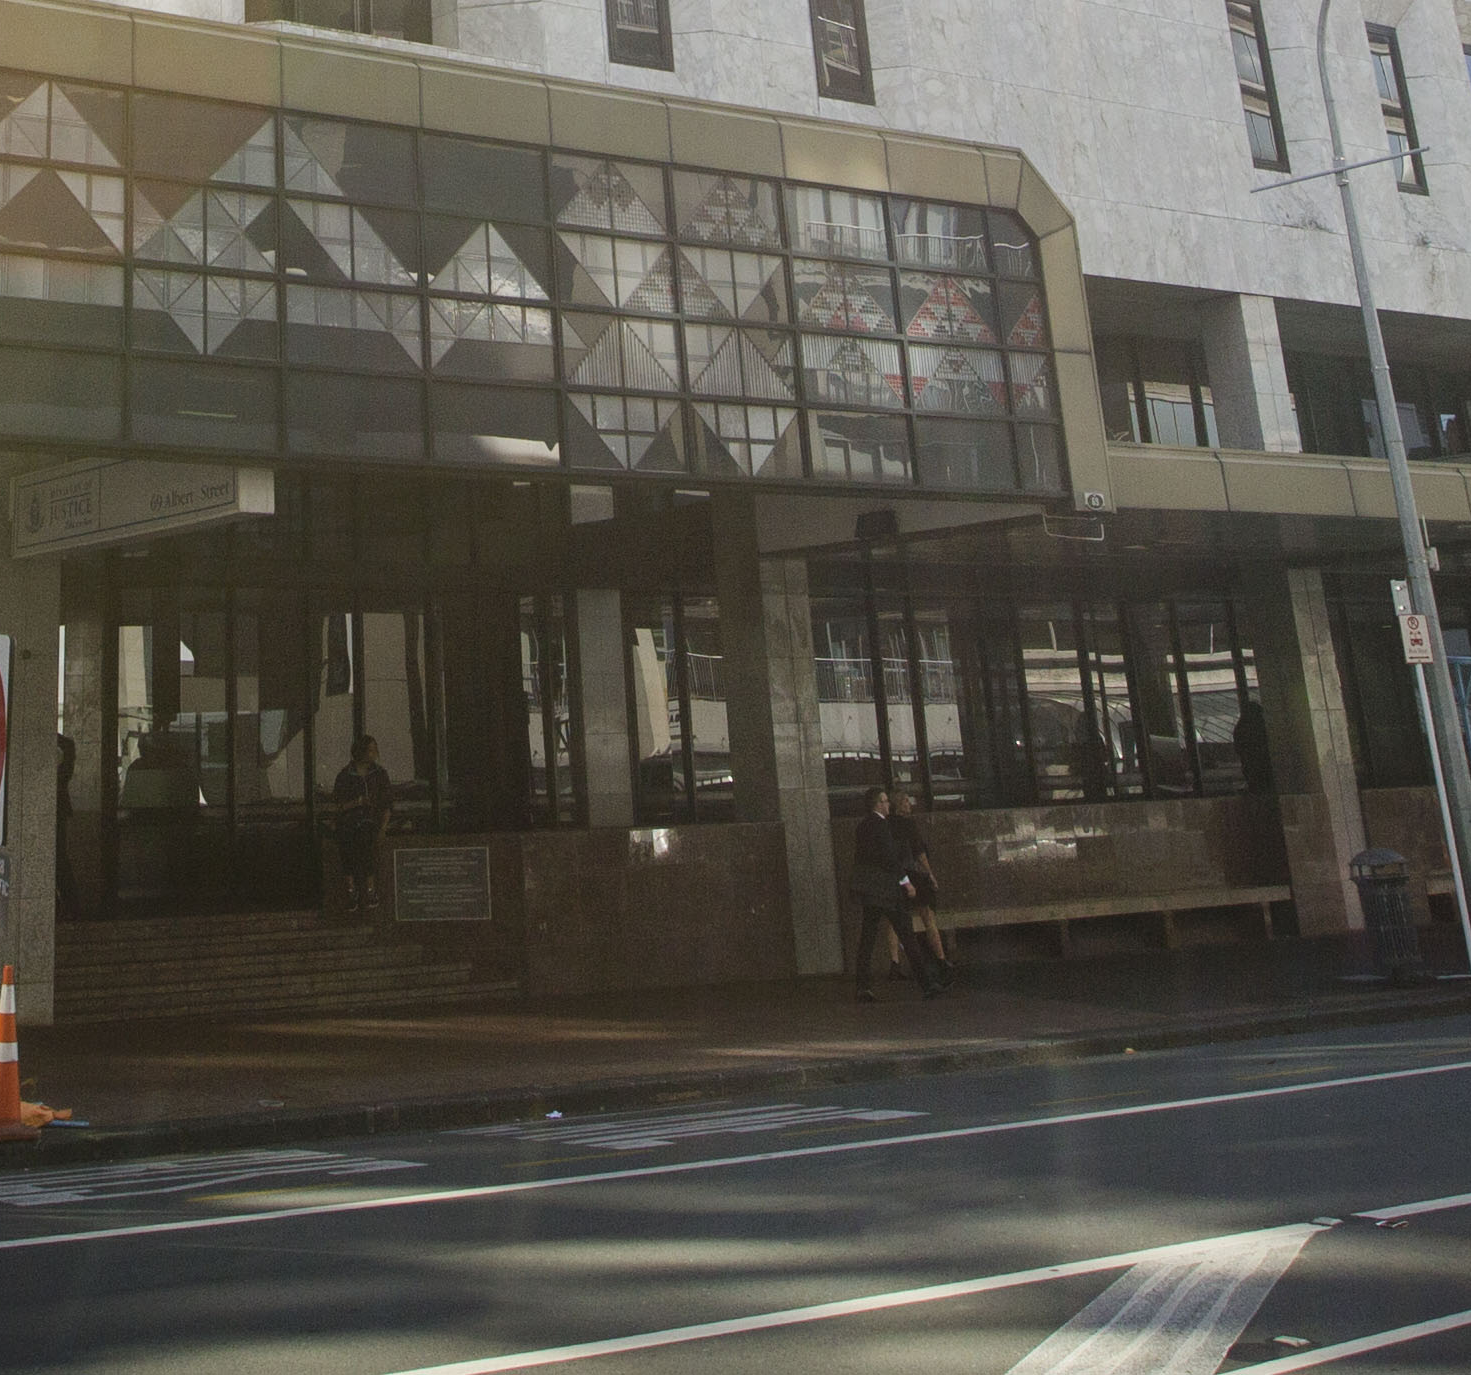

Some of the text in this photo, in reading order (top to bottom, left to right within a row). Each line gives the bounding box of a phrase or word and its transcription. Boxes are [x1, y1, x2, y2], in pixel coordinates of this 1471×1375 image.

[163, 488, 194, 508] Albert
[199, 481, 229, 500] Street
[49, 497, 91, 526] JUSTICE
